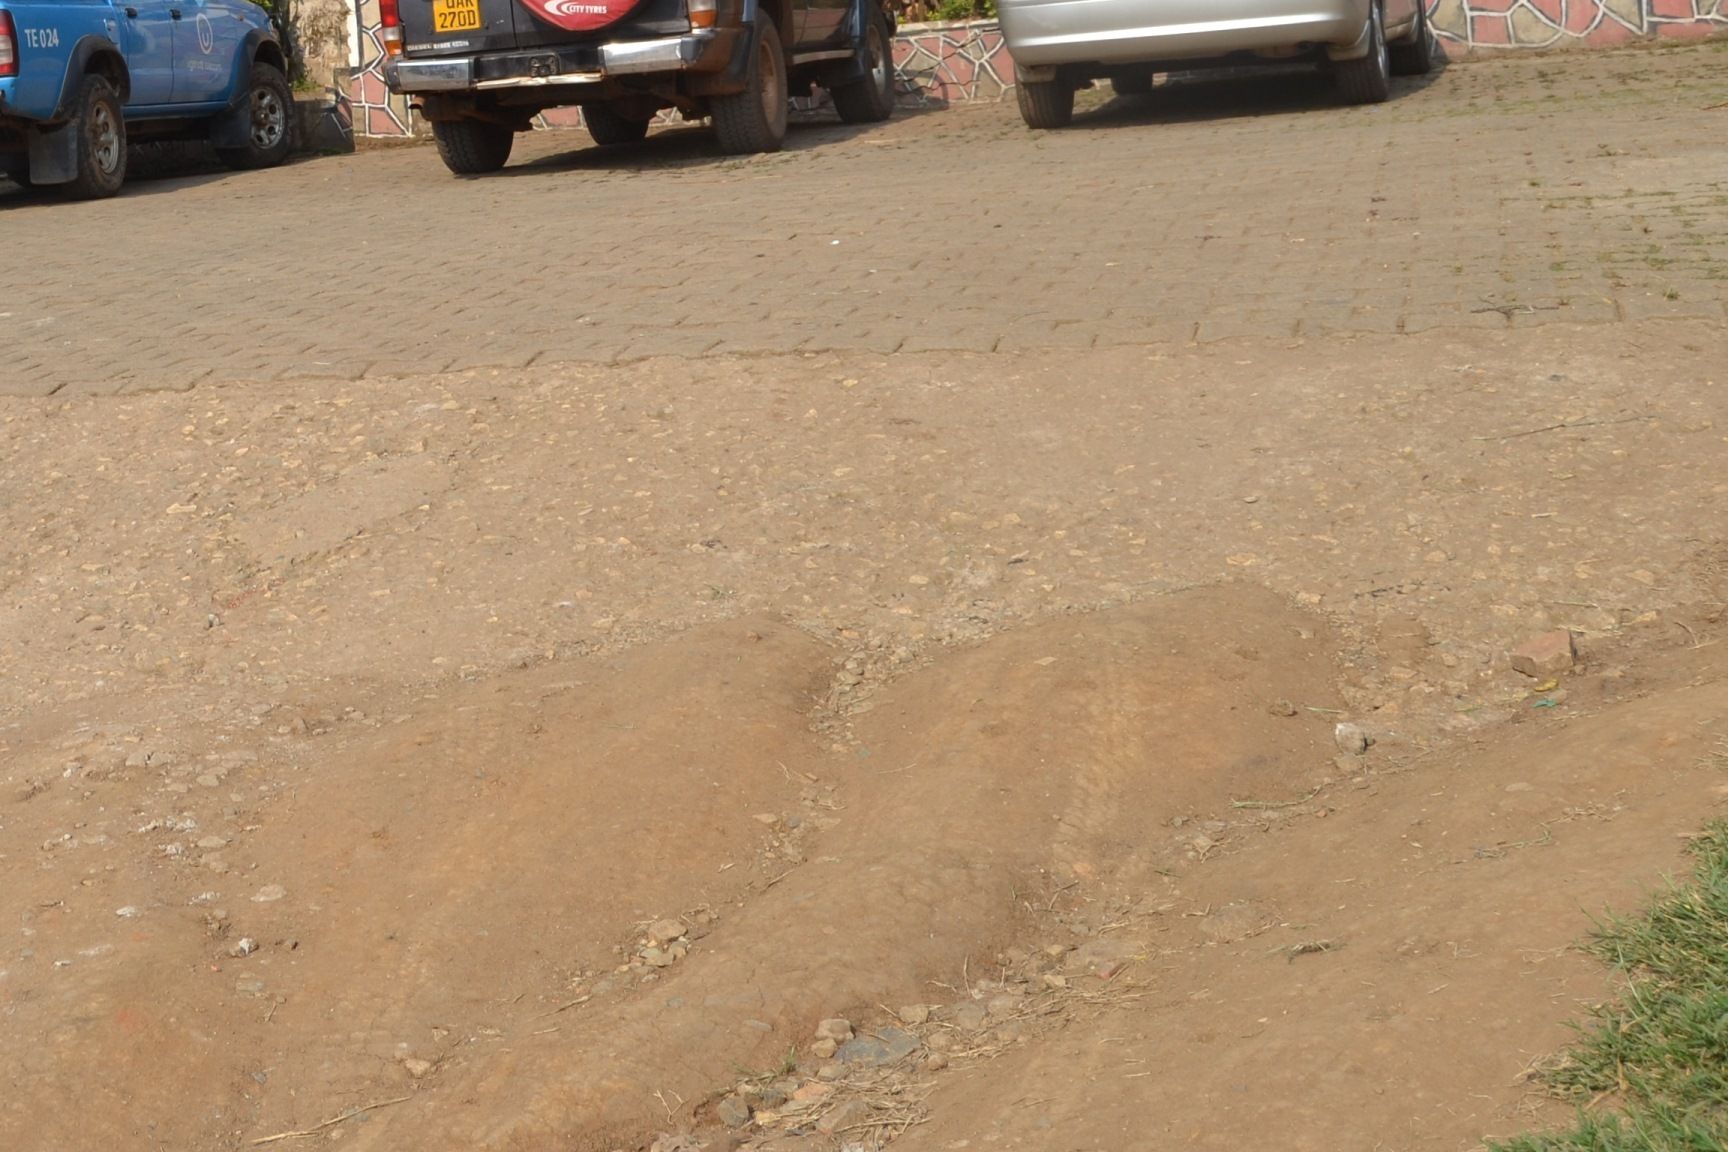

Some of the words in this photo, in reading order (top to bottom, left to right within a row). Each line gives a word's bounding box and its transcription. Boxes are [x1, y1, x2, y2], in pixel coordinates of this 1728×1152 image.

[569, 4, 584, 13] CITY
[585, 4, 607, 14] TYRES
[439, 10, 477, 29] 270D
[24, 28, 39, 48] TE
[39, 28, 59, 48] 024
